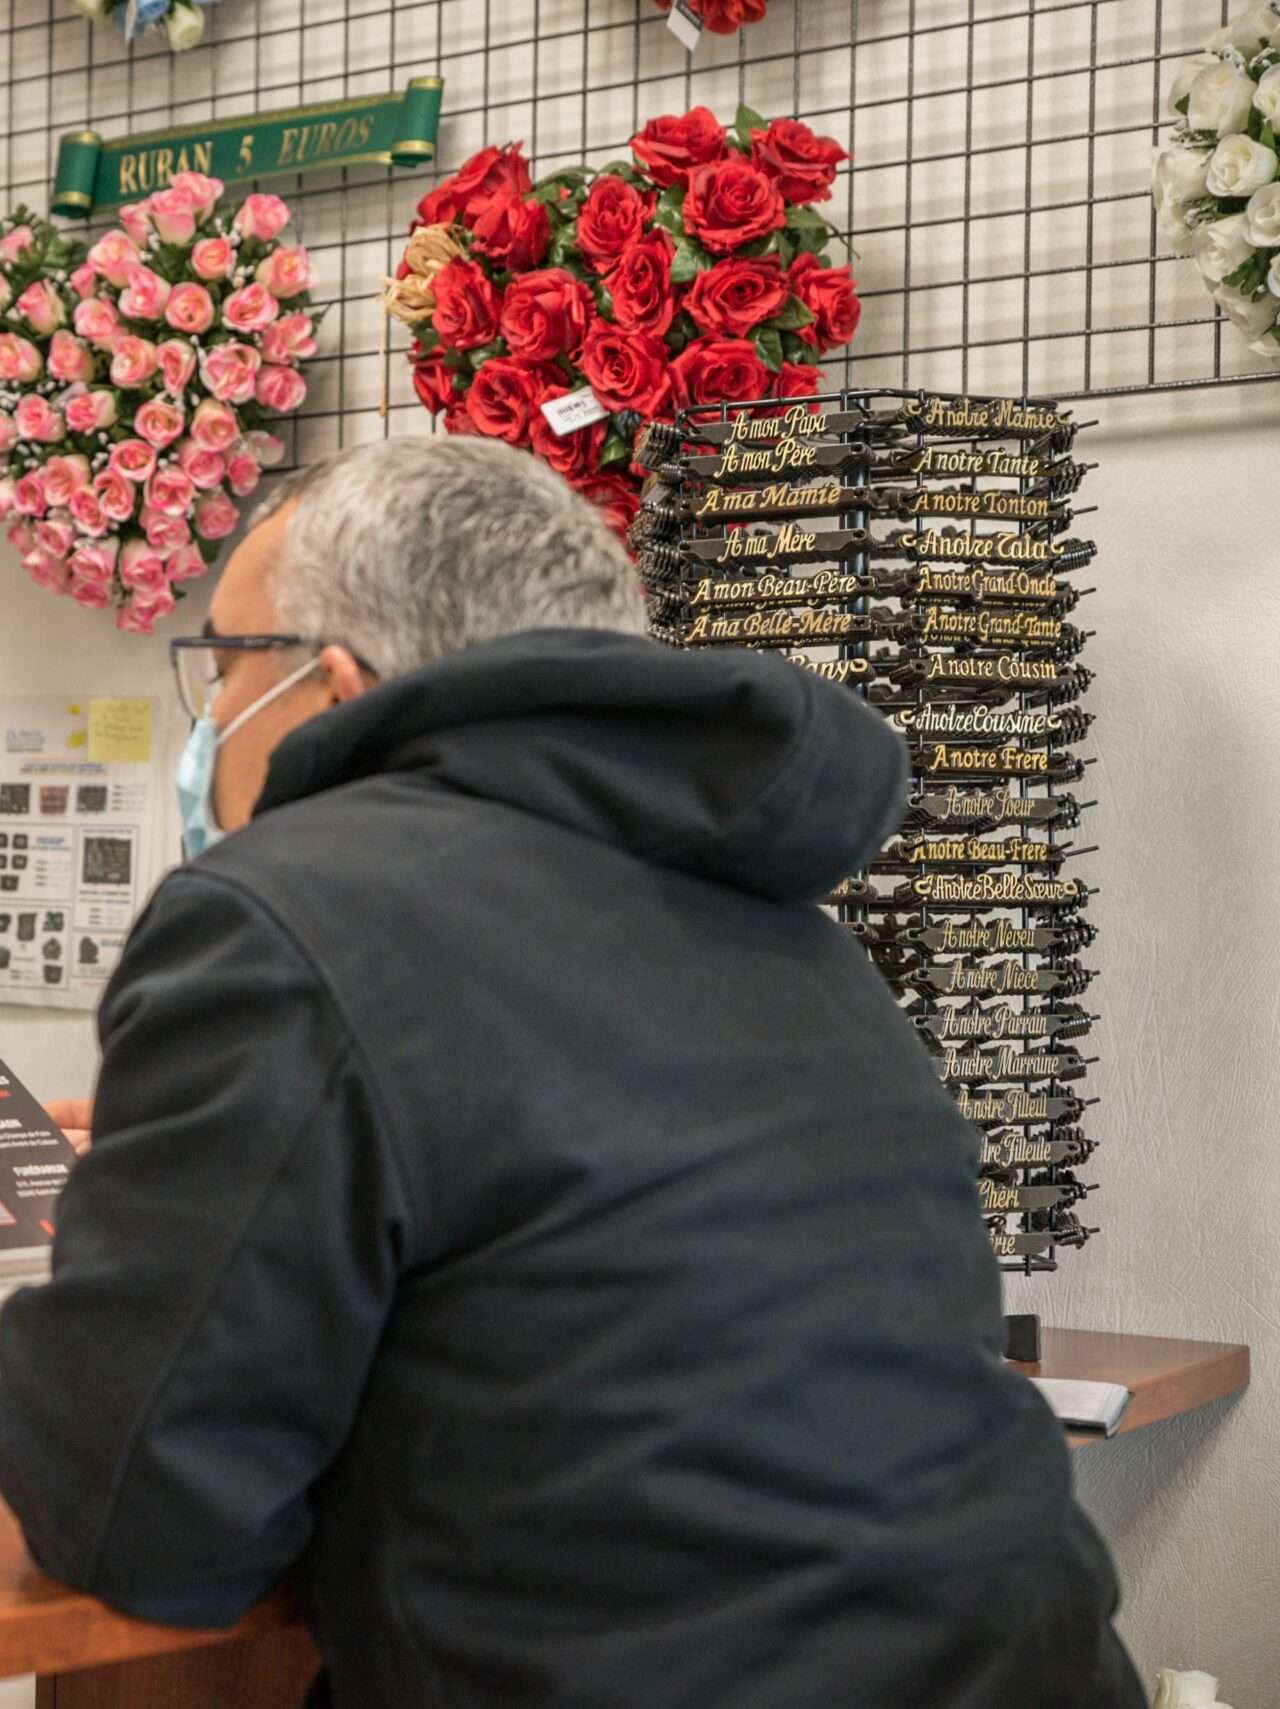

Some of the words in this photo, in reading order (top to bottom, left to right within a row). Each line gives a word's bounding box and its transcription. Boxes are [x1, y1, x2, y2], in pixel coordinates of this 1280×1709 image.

[120, 141, 212, 193] RUBAN
[239, 135, 254, 173] 5
[277, 115, 374, 165] EUROS
[725, 411, 747, 444] A
[750, 419, 779, 439] mon
[781, 405, 826, 439] Papa
[995, 399, 1056, 428] Mamie
[714, 445, 737, 478] A
[741, 453, 770, 472] mon
[912, 447, 932, 472] A
[937, 451, 982, 472] notre
[988, 451, 1038, 475] Tante
[696, 489, 722, 515] A
[723, 493, 755, 509] ma
[760, 484, 841, 507] Mamie
[912, 489, 928, 512] A
[933, 492, 980, 512] notre
[984, 491, 1048, 516] Tonton
[718, 528, 741, 562] A
[745, 536, 767, 556] ma
[690, 578, 712, 604] A
[714, 581, 754, 599] mon
[972, 569, 1057, 600] Grand-Oncle
[686, 615, 710, 641] A
[711, 620, 739, 636] ma
[978, 611, 1061, 640] Grand-Tante
[928, 654, 946, 679] A
[948, 658, 993, 676] notre
[998, 656, 1056, 680] Cousin
[973, 705, 1045, 733] Cousine
[929, 744, 949, 770] A
[951, 749, 996, 767] notre
[961, 788, 994, 815] notre
[928, 841, 965, 860] notre
[937, 919, 957, 951] A
[959, 922, 989, 947] notre
[991, 919, 1034, 951] Neveu
[946, 960, 965, 992] A
[967, 967, 997, 989] notre
[937, 1005, 958, 1039] A
[960, 1008, 991, 1035] notre
[992, 1006, 1047, 1038] Parrain
[940, 1048, 960, 1080] A
[961, 1050, 992, 1076] notre
[992, 1046, 1059, 1080] Marraine
[973, 1090, 1005, 1119] notre
